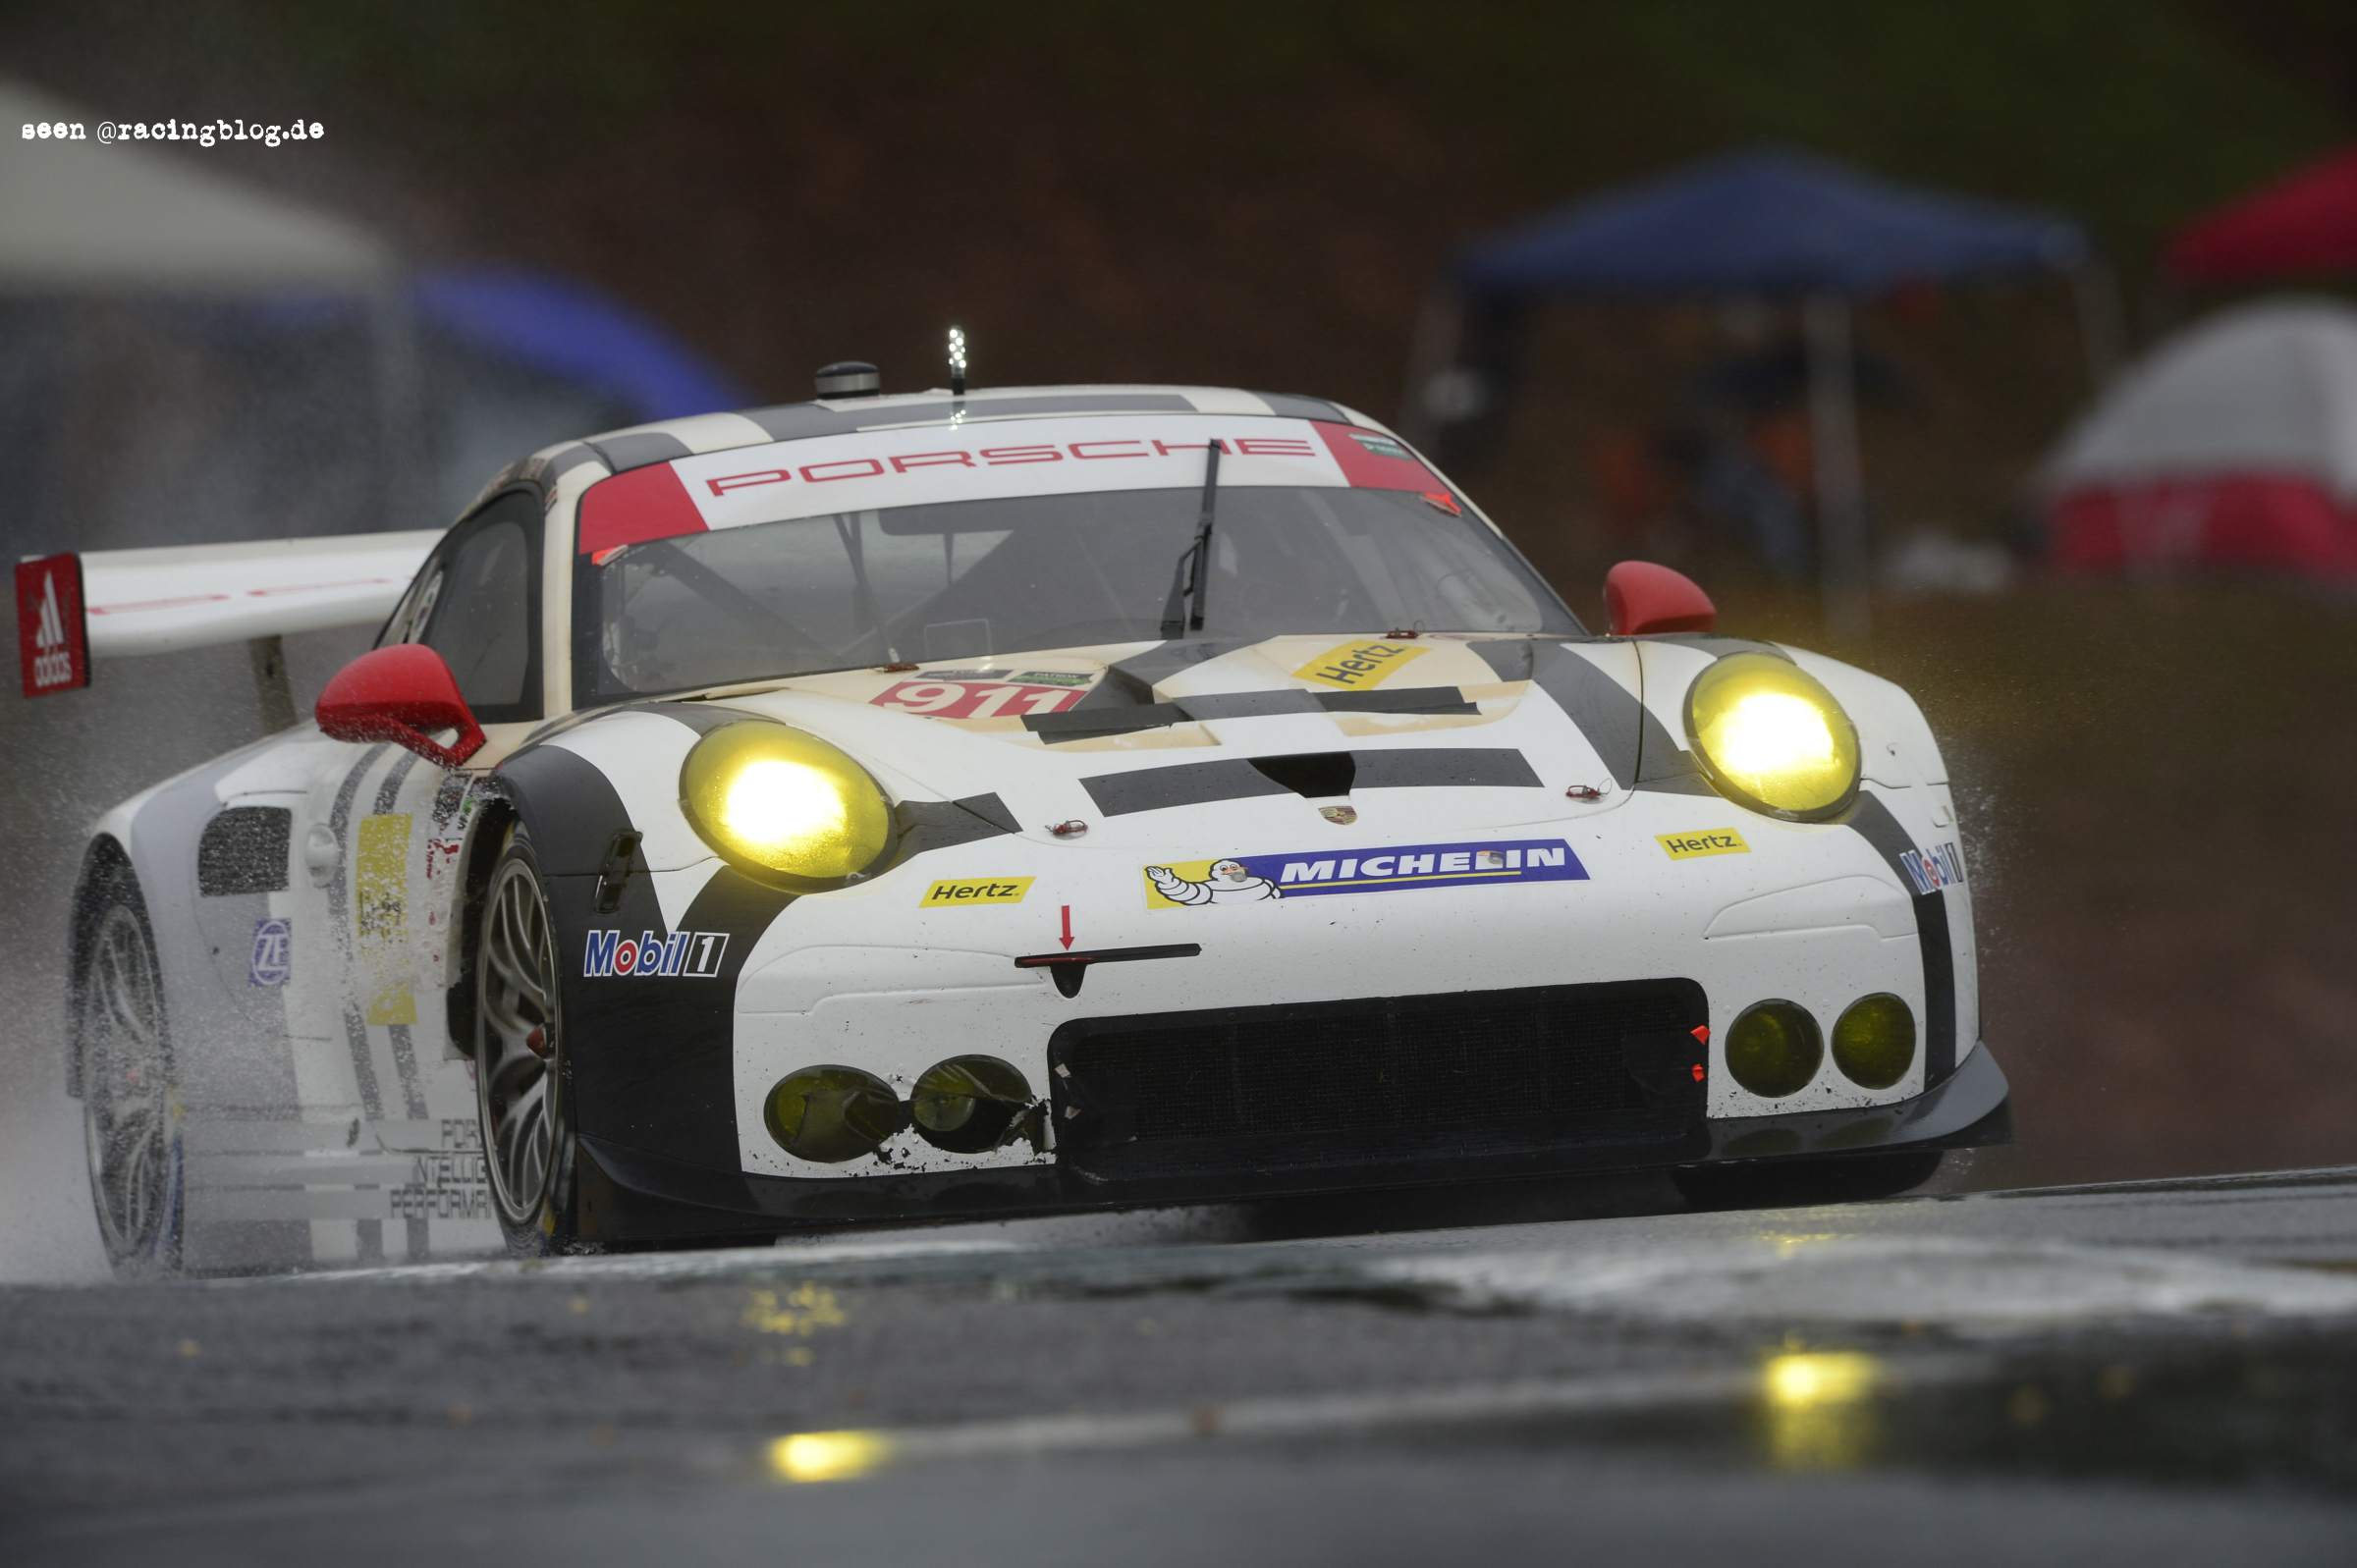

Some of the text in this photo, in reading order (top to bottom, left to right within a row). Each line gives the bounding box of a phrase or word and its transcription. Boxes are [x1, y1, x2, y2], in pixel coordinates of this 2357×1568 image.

[706, 438, 1317, 497] PORSCHE
[1316, 644, 1405, 685] Hertz
[883, 683, 1072, 718] 911
[1666, 835, 1737, 853] Hertz
[1280, 847, 1566, 883] MICHELIN
[1899, 844, 1956, 895] Mobil
[931, 883, 1017, 900] Hertz
[583, 930, 690, 977] Mobil
[391, 1189, 492, 1219] PERFORMA
